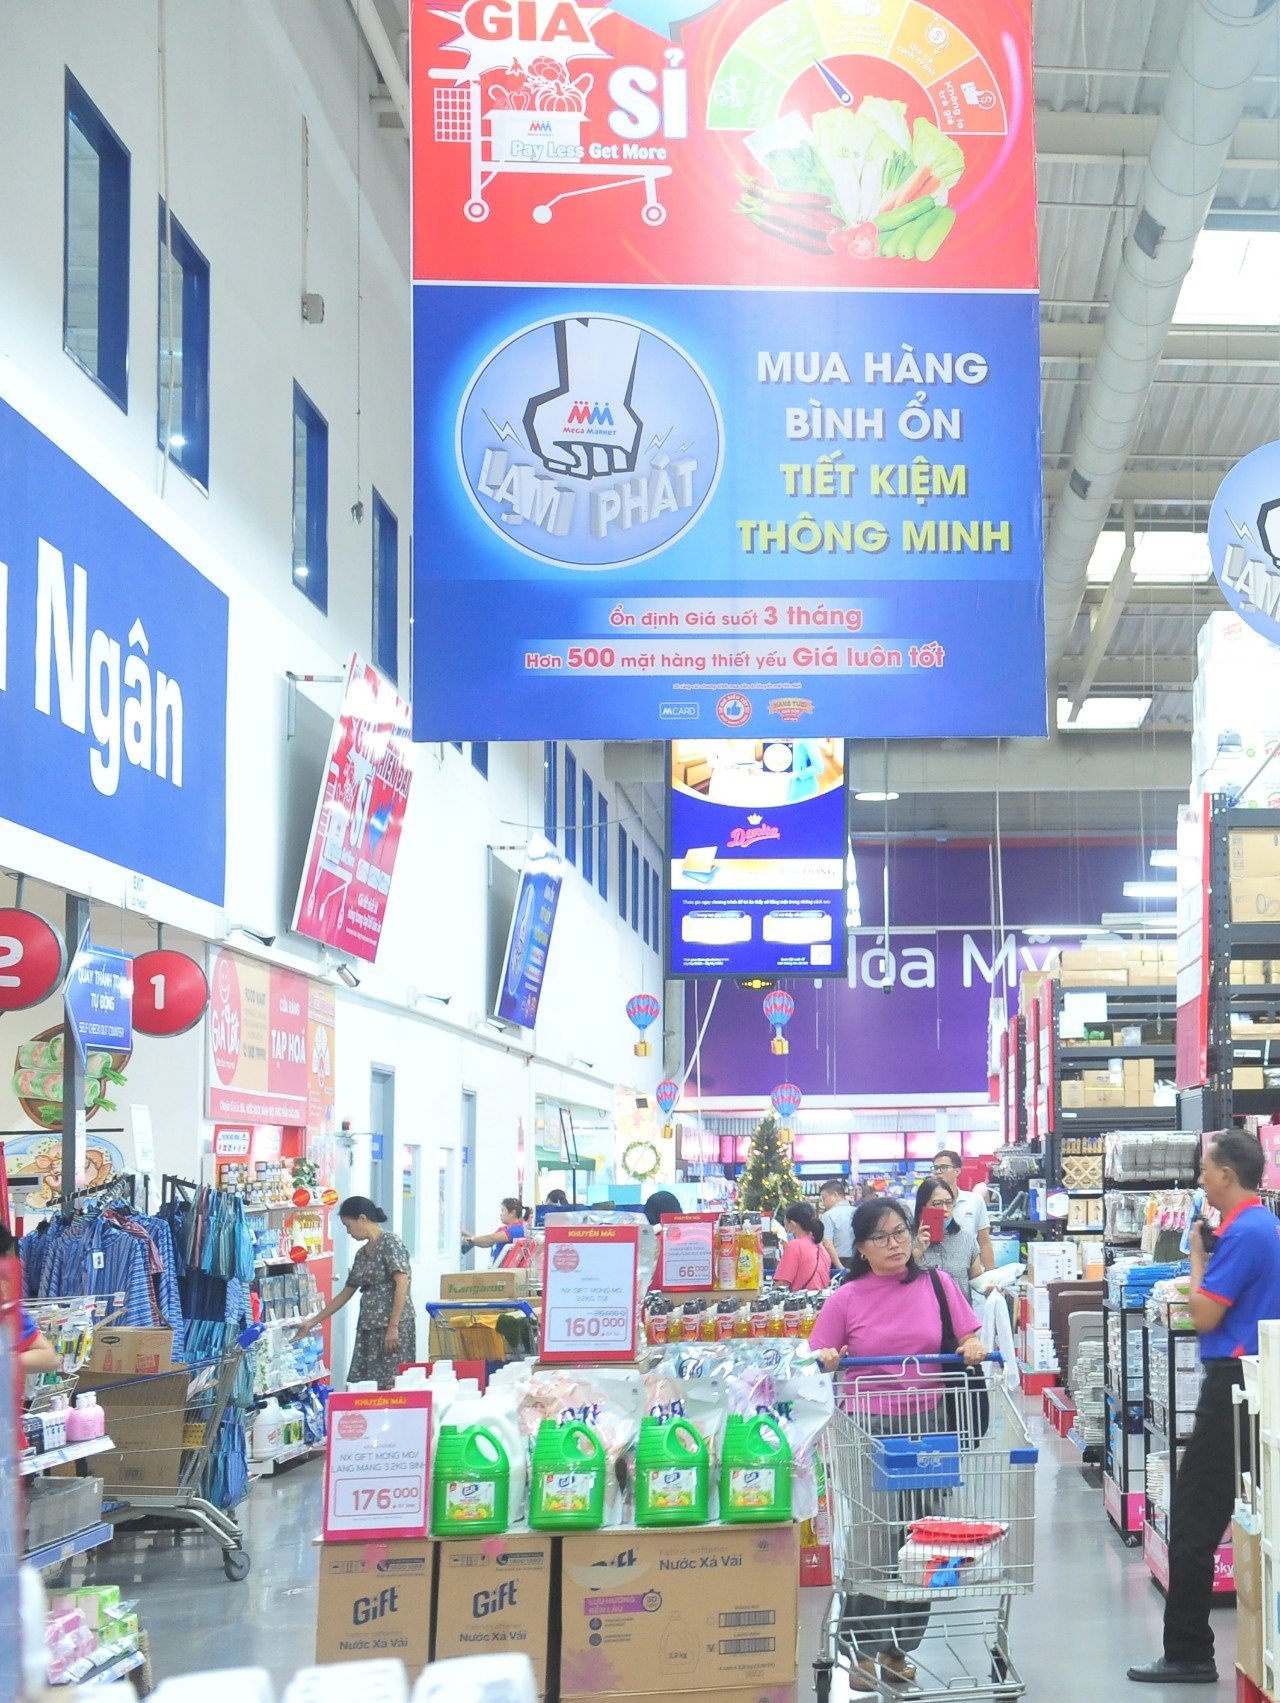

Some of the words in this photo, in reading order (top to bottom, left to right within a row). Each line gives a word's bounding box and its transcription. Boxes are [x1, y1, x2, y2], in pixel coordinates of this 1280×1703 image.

[511, 141, 543, 160] Pay
[547, 142, 584, 159] Less
[588, 143, 619, 159] Get
[623, 144, 667, 160] More
[757, 351, 851, 384] MUA
[864, 342, 988, 384] HÀNG
[786, 397, 883, 440] BÌNH
[898, 390, 961, 440] ỔN
[590, 453, 698, 538] PHÁT
[780, 450, 856, 496] TIẾT
[870, 454, 967, 505] KIỆM
[736, 511, 889, 553] THÔNG
[903, 520, 1010, 553] MINH
[610, 604, 635, 626] Ổn
[641, 612, 679, 629] định
[685, 611, 716, 626] Giá
[722, 609, 759, 626] suốt
[764, 605, 778, 626] 3
[787, 604, 862, 631] tháng
[35, 536, 183, 796] Ngân
[526, 654, 562, 668] Hơn
[568, 647, 615, 668] 500
[621, 653, 656, 671] mặt
[661, 653, 706, 670] hàng
[712, 650, 750, 667] thiết
[756, 650, 787, 669] yếu
[793, 645, 838, 667] Giá
[847, 645, 901, 667] luôn
[909, 641, 944, 668] tốt
[150, 973, 165, 1010] 1
[271, 1029, 287, 1068] TẠP
[660, 1556, 697, 1571] Nước
[352, 1586, 399, 1626] Gift
[472, 1579, 518, 1619] Gift
